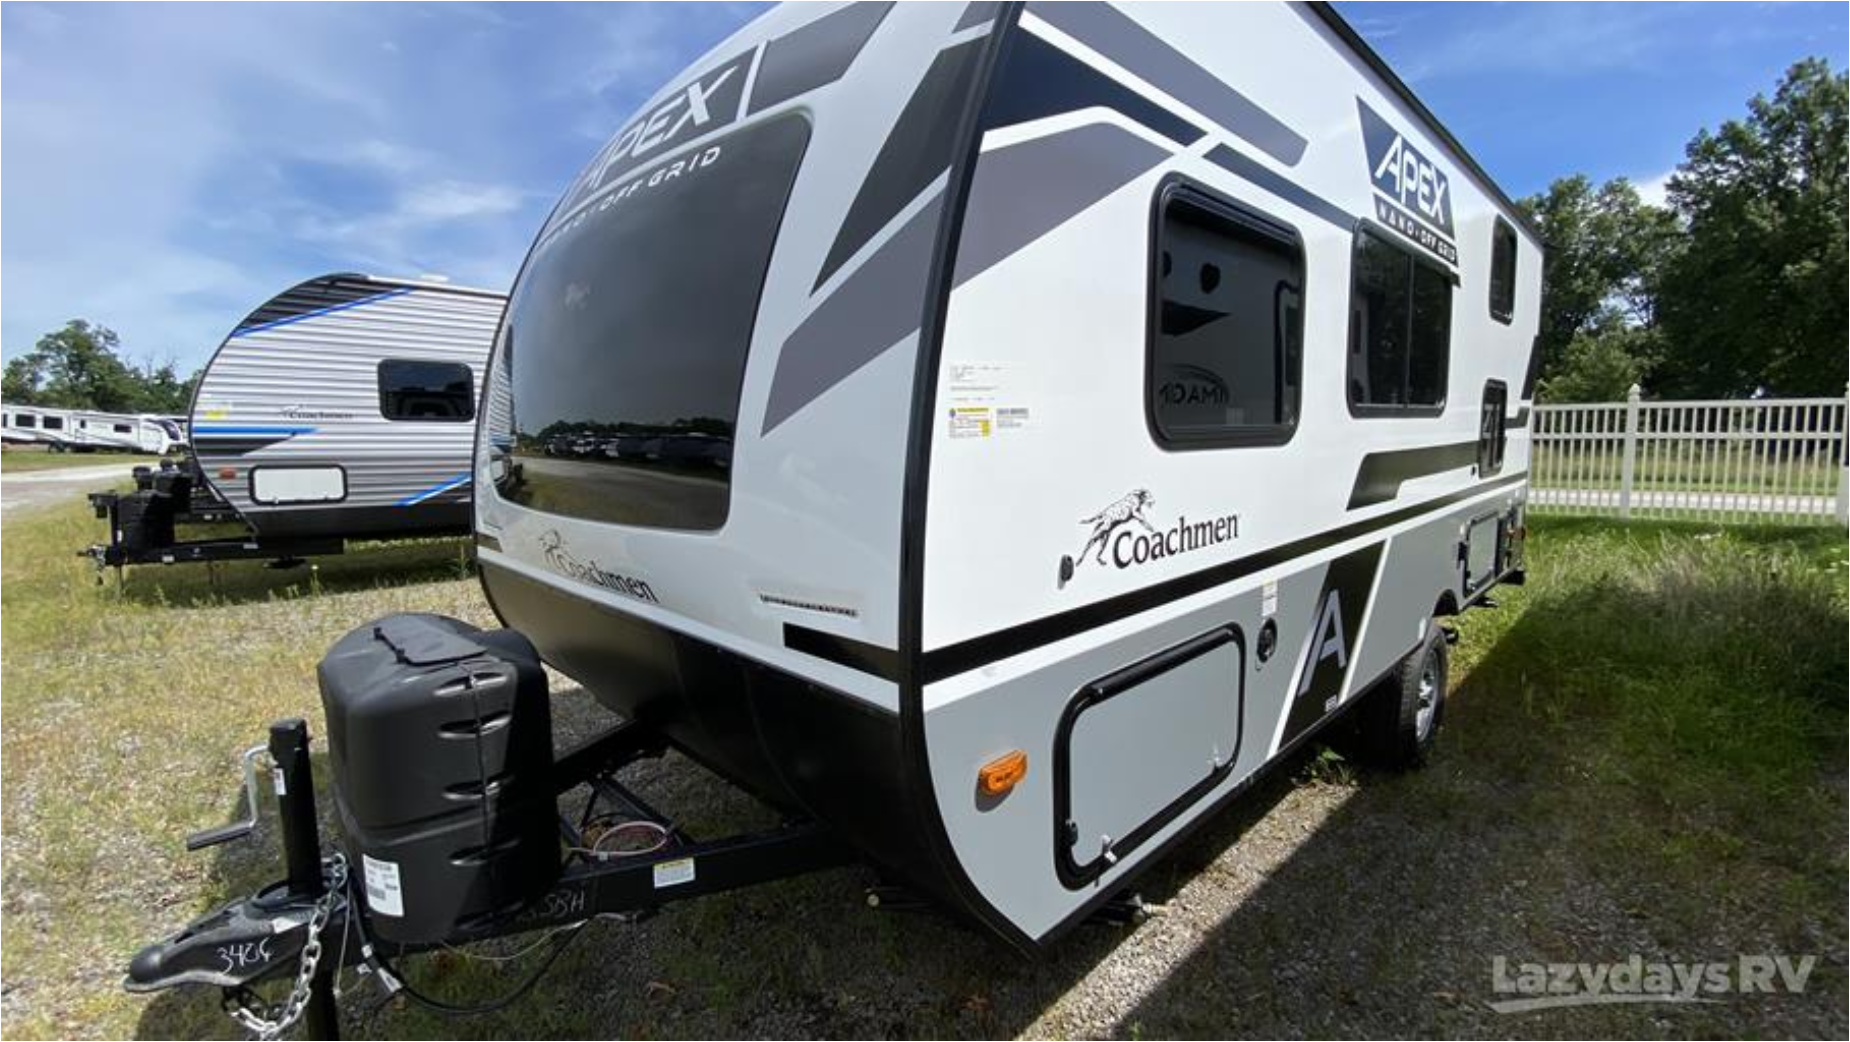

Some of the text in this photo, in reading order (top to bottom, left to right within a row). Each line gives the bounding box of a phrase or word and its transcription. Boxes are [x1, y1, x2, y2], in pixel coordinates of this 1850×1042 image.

[600, 147, 721, 211] OFF GRID
[1374, 134, 1446, 225] APEX
[1380, 202, 1456, 262] NANO OFF GRID
[1112, 513, 1239, 569] Coachmen
[556, 553, 660, 604] Coachmen
[1297, 588, 1346, 698] A
